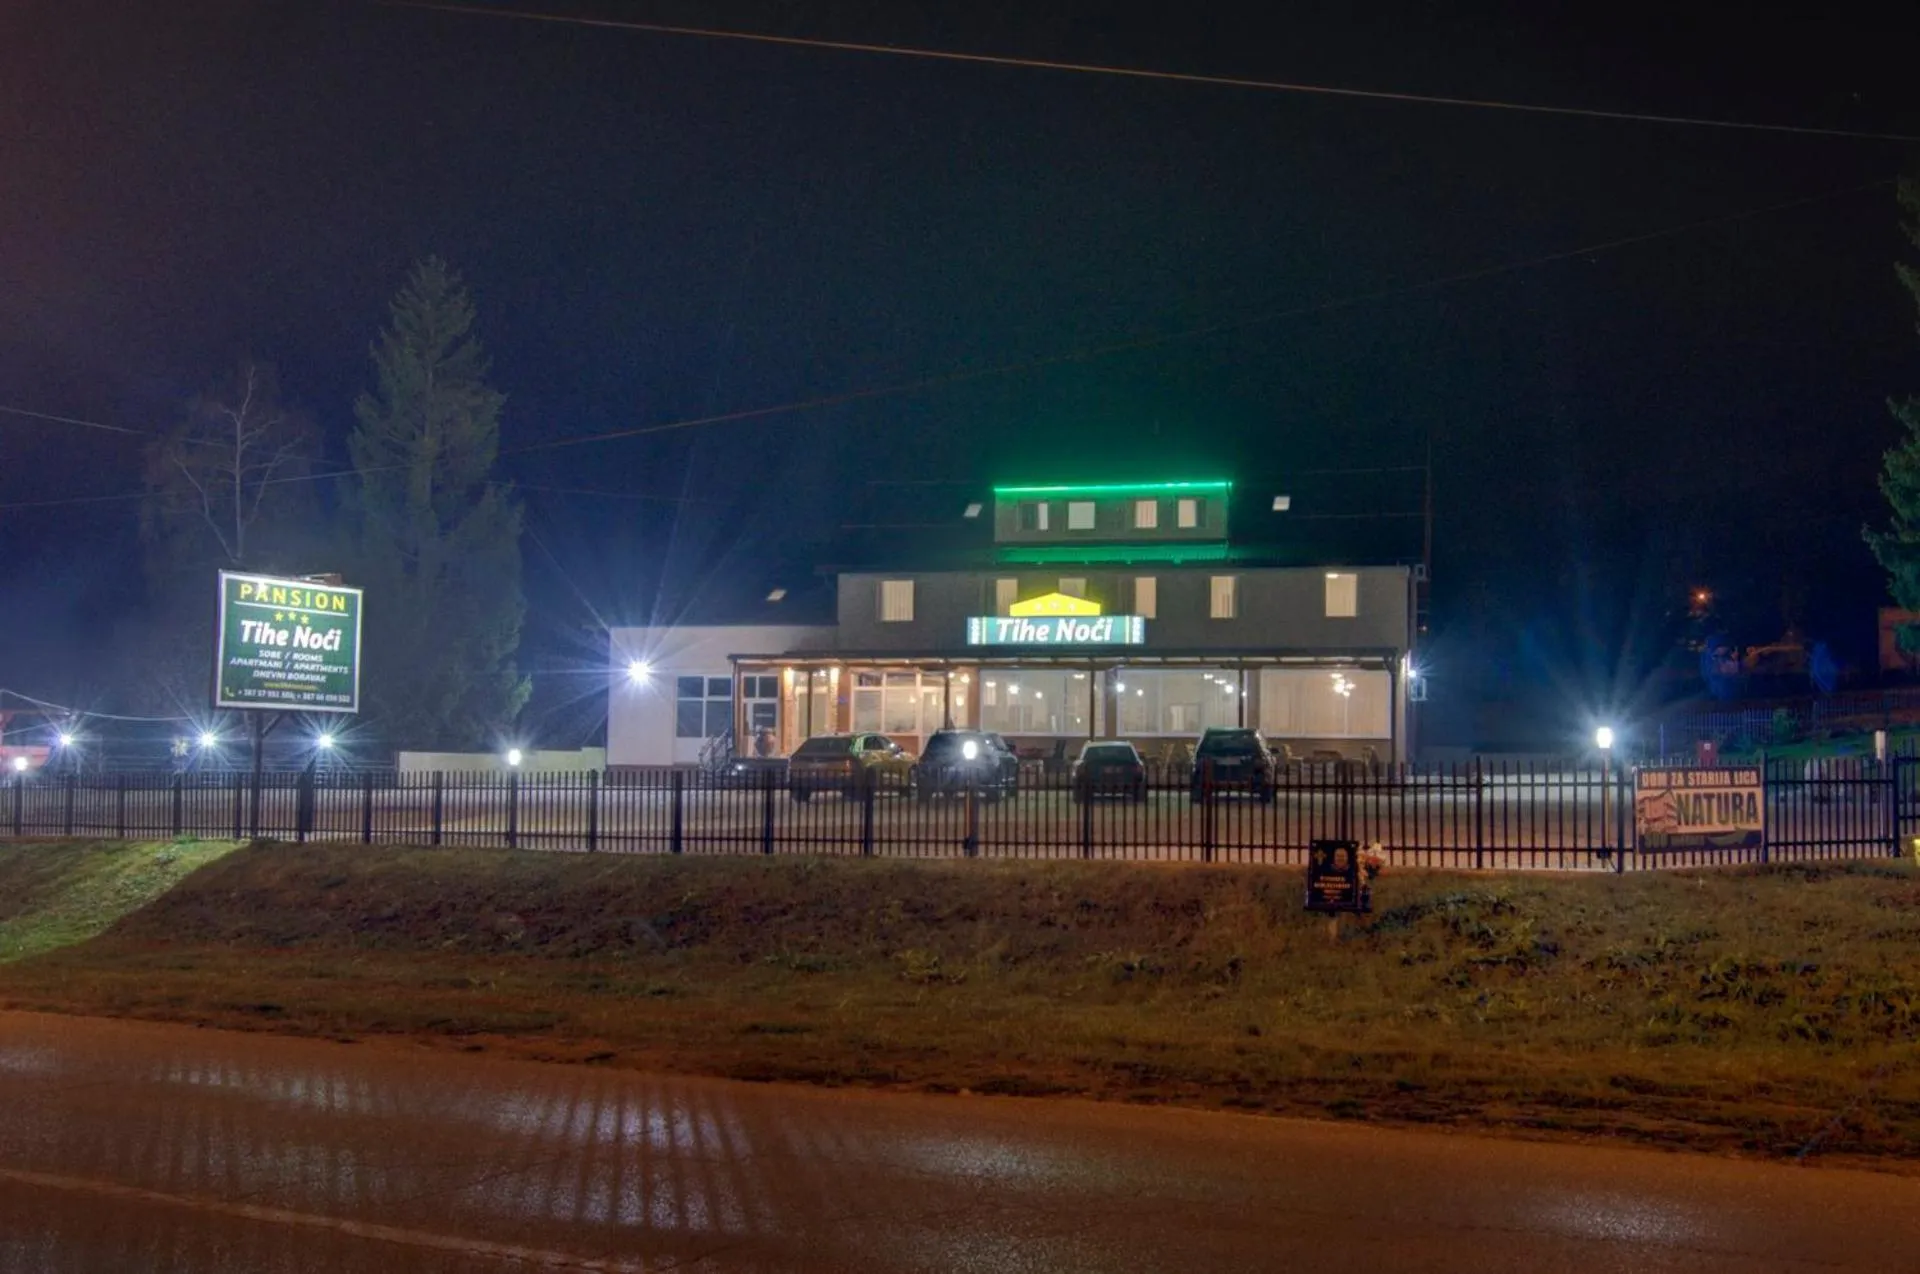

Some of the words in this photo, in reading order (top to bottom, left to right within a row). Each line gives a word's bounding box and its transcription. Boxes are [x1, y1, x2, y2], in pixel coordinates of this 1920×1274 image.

[240, 583, 345, 610] PANSION
[241, 620, 289, 646] Tihe
[292, 625, 341, 651] Noći
[996, 618, 1050, 643] Tihe
[1055, 618, 1113, 643] Noći
[229, 657, 283, 669] APARTMANI
[293, 662, 348, 675] APARTMENTS
[259, 650, 282, 660] SOBE
[292, 652, 323, 662] ROOMS
[253, 669, 286, 680] DNEVNI
[287, 671, 326, 683] BORAVAK
[1642, 771, 1668, 788] DOM
[1671, 771, 1685, 787] ZA
[1688, 770, 1731, 787] STARIJA
[1734, 769, 1758, 786] LICA
[1676, 791, 1759, 827] NATURA
